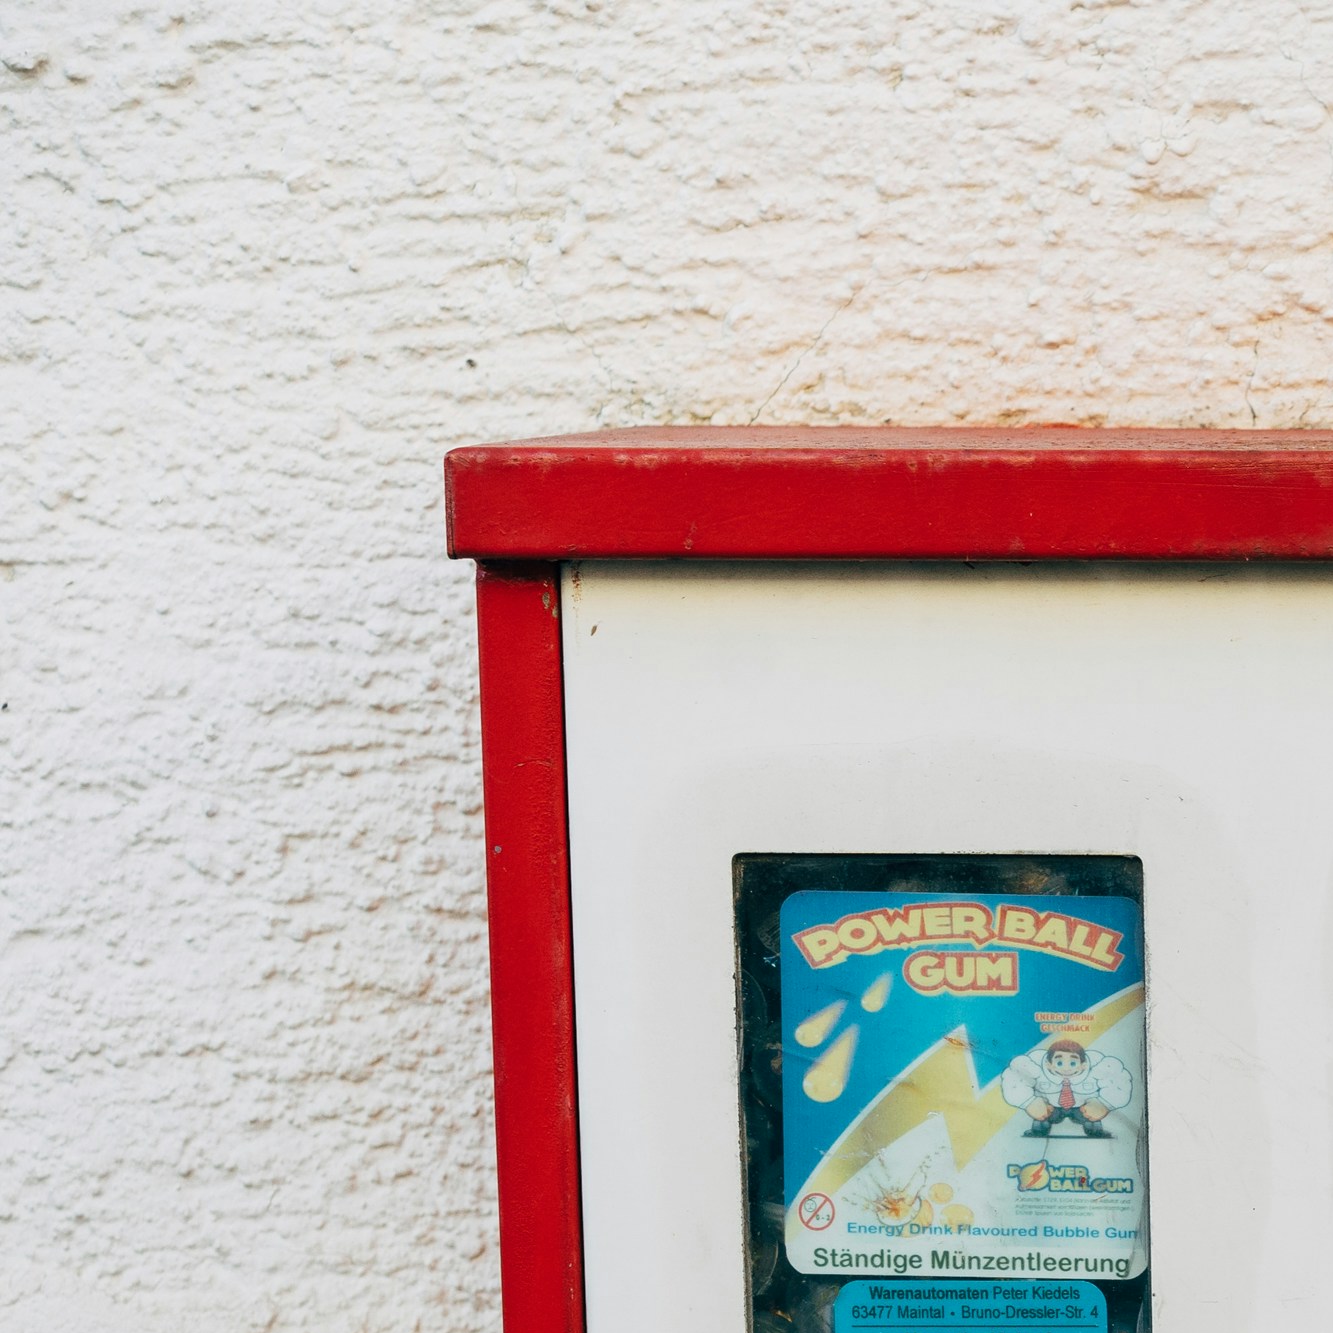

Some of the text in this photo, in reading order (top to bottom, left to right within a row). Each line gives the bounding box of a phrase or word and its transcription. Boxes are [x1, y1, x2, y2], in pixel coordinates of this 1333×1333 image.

[798, 904, 1122, 967] POWER BALL
[908, 955, 1015, 990] GUM
[1050, 1179, 1133, 1193] BALL GUM
[847, 1222, 904, 1238] Energy
[909, 1223, 953, 1236] Drink
[958, 1224, 1037, 1238] Flavoured
[1043, 1225, 1100, 1238] Bubble
[812, 1247, 1130, 1278] Ständige Münzentleerung
[869, 1286, 1081, 1300] Warenautomaten Peter Kiedels
[852, 1305, 1099, 1319] 63477 Maintal Bruno-Dressler-Str. 4
